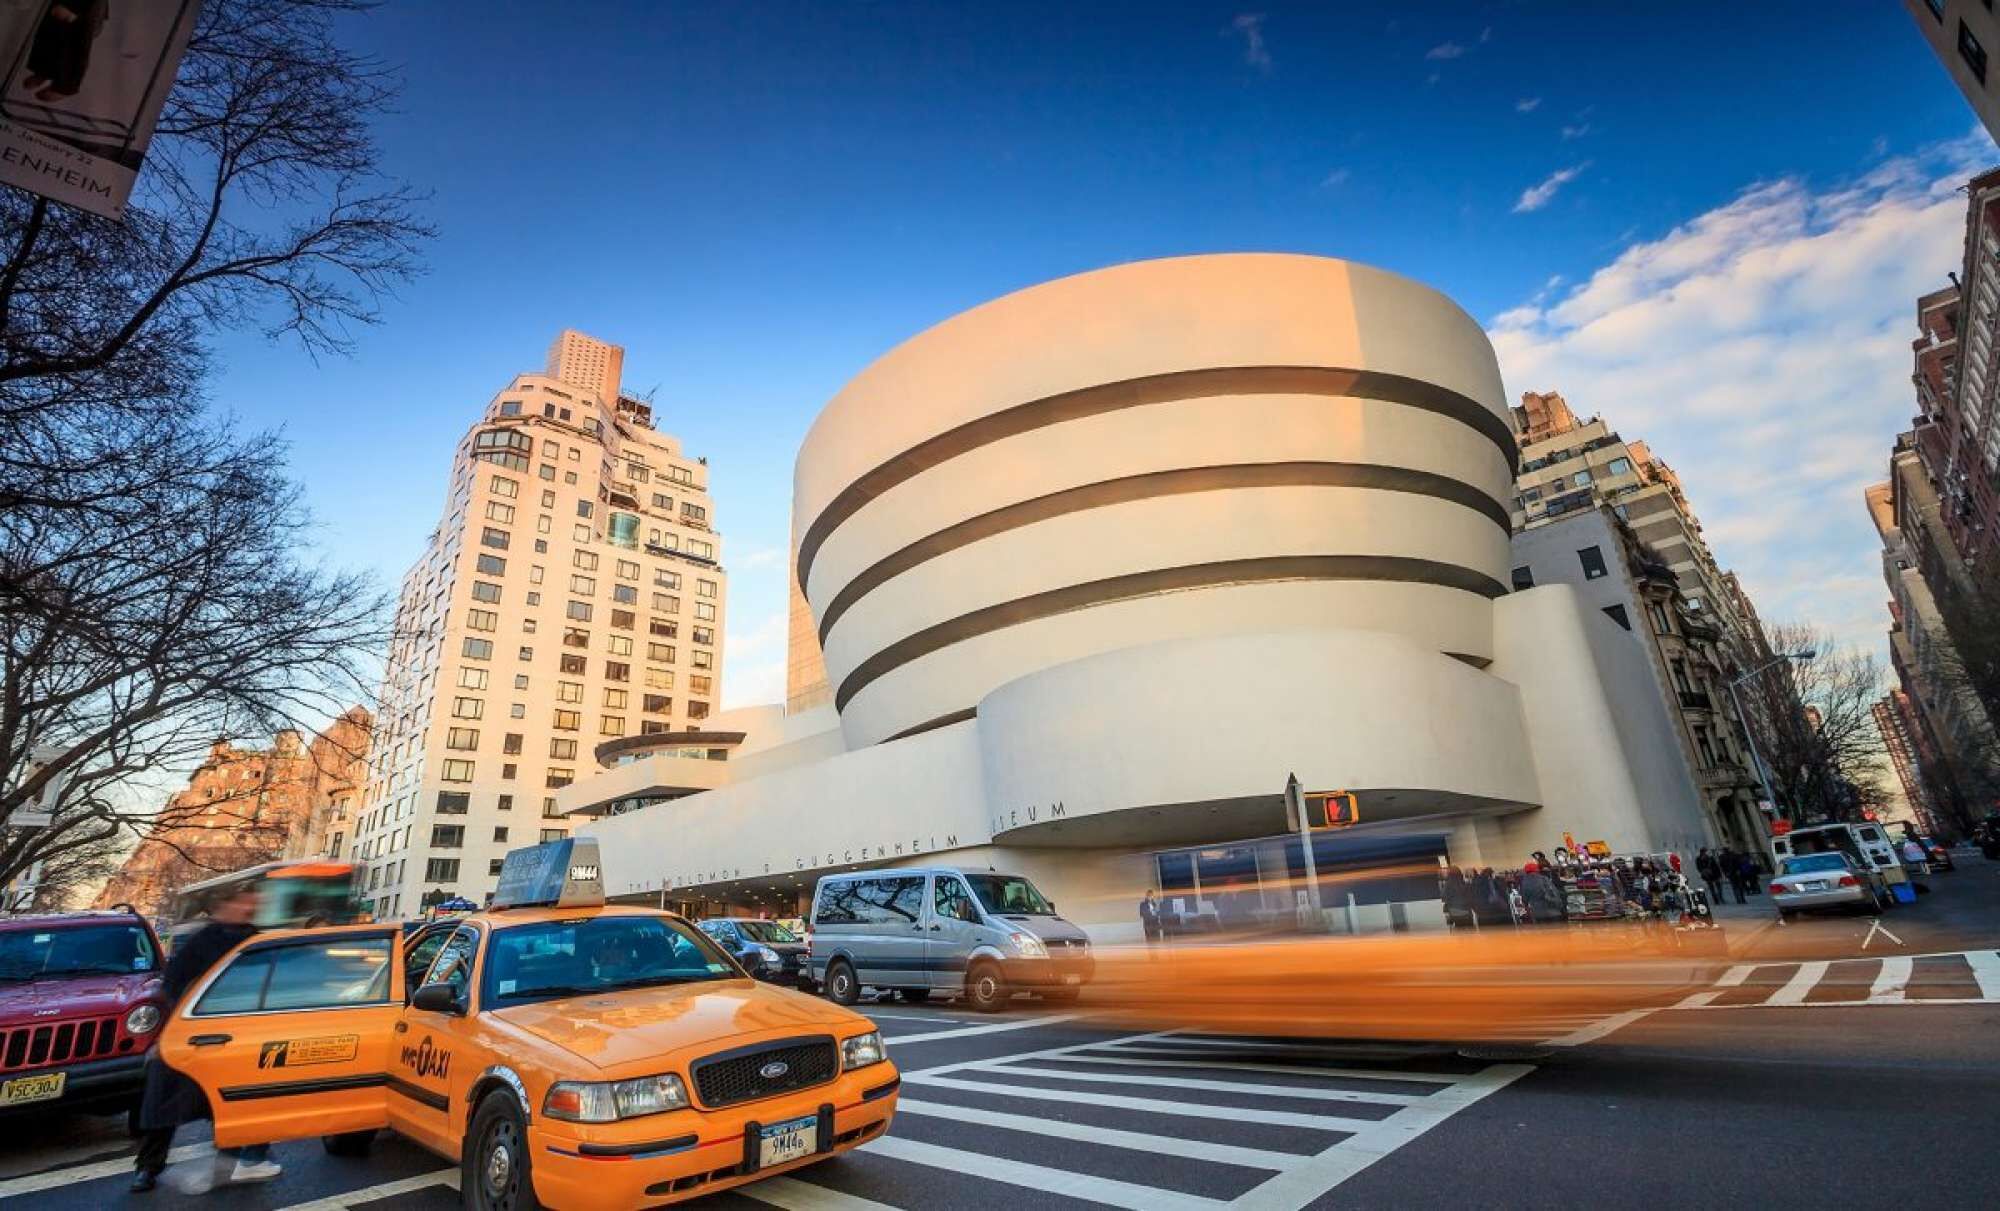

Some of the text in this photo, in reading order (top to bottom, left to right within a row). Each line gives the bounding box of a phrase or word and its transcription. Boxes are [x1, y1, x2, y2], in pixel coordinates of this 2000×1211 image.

[17, 130, 73, 158] January
[795, 835, 958, 870] GUGGENHEIM
[571, 867, 598, 880] 9M44
